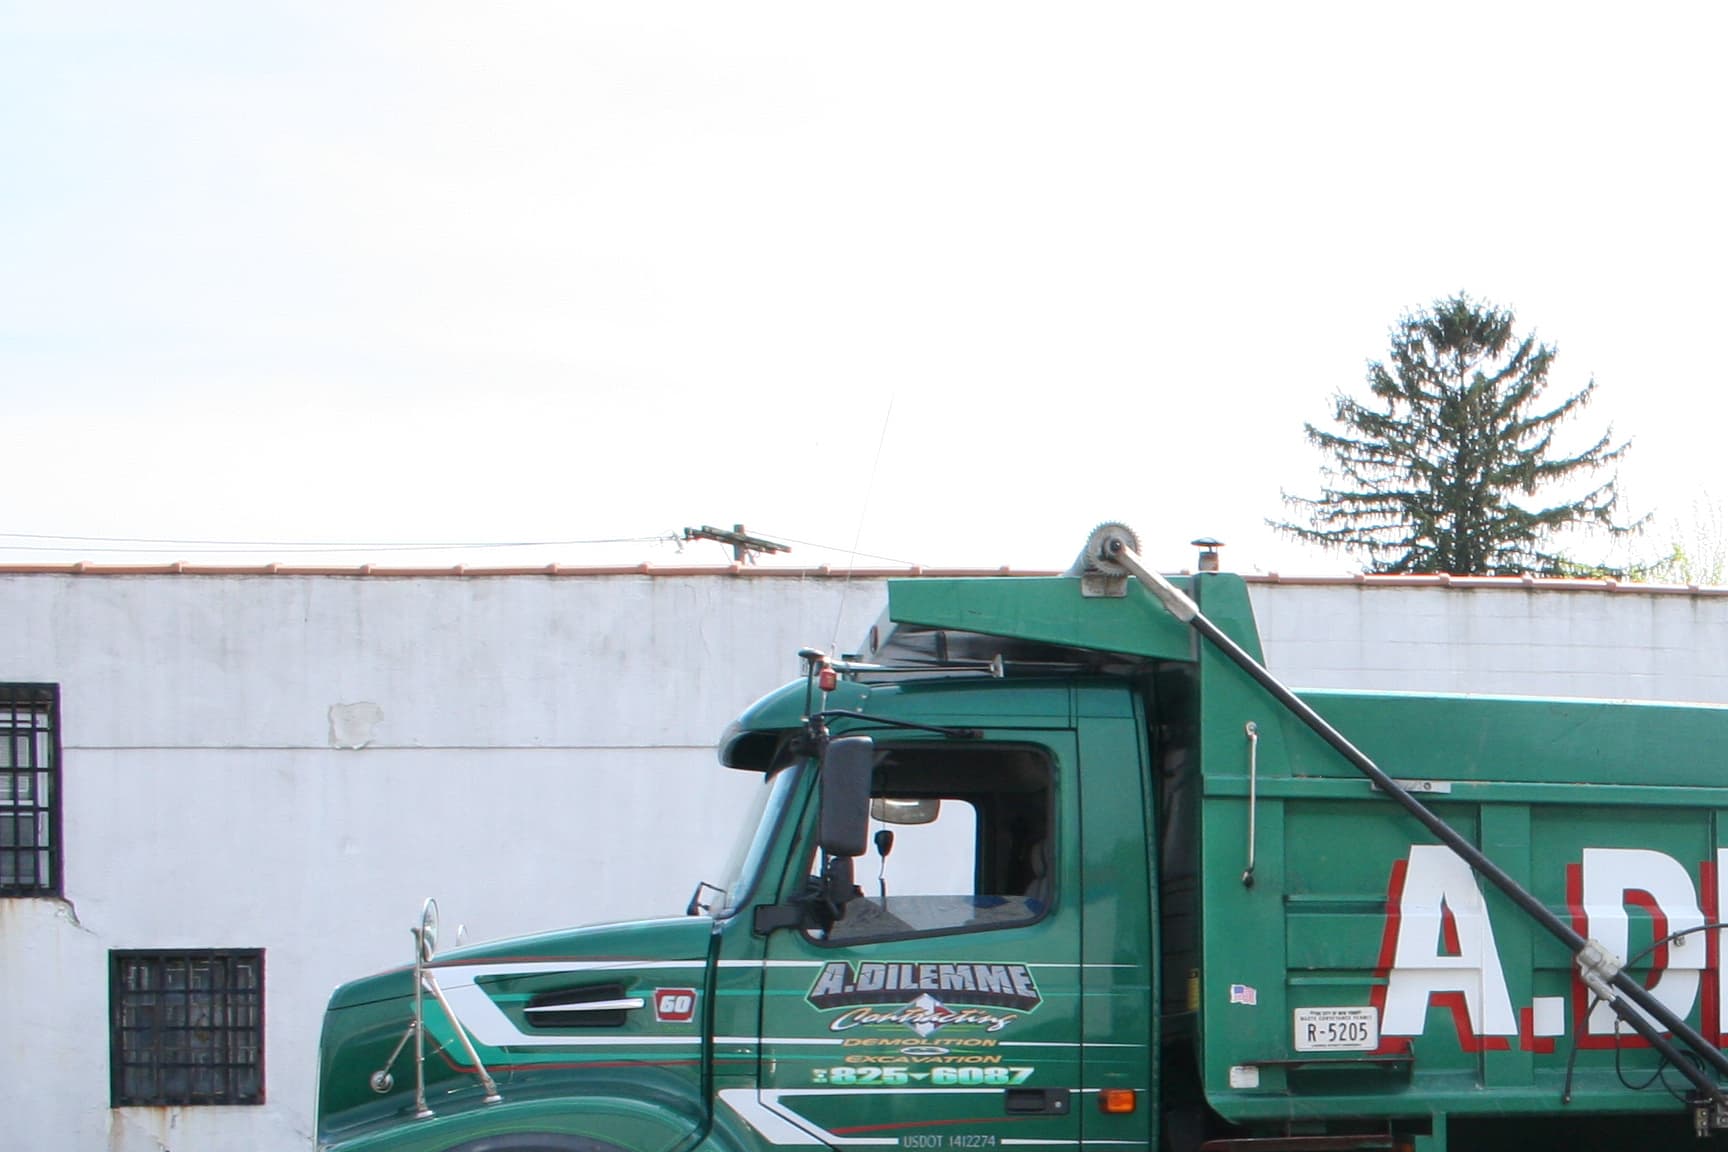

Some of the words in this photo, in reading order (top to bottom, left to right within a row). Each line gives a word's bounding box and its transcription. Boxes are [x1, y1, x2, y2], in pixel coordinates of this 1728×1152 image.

[659, 995, 692, 1014] 60
[829, 1006, 1018, 1032] Contracting
[1307, 1022, 1368, 1042] R-5205
[842, 1038, 998, 1048] DEMOLITION
[844, 1055, 1002, 1064] EXCAVATION
[903, 1135, 943, 1148] USDOT
[949, 1135, 996, 1148] 1412274
